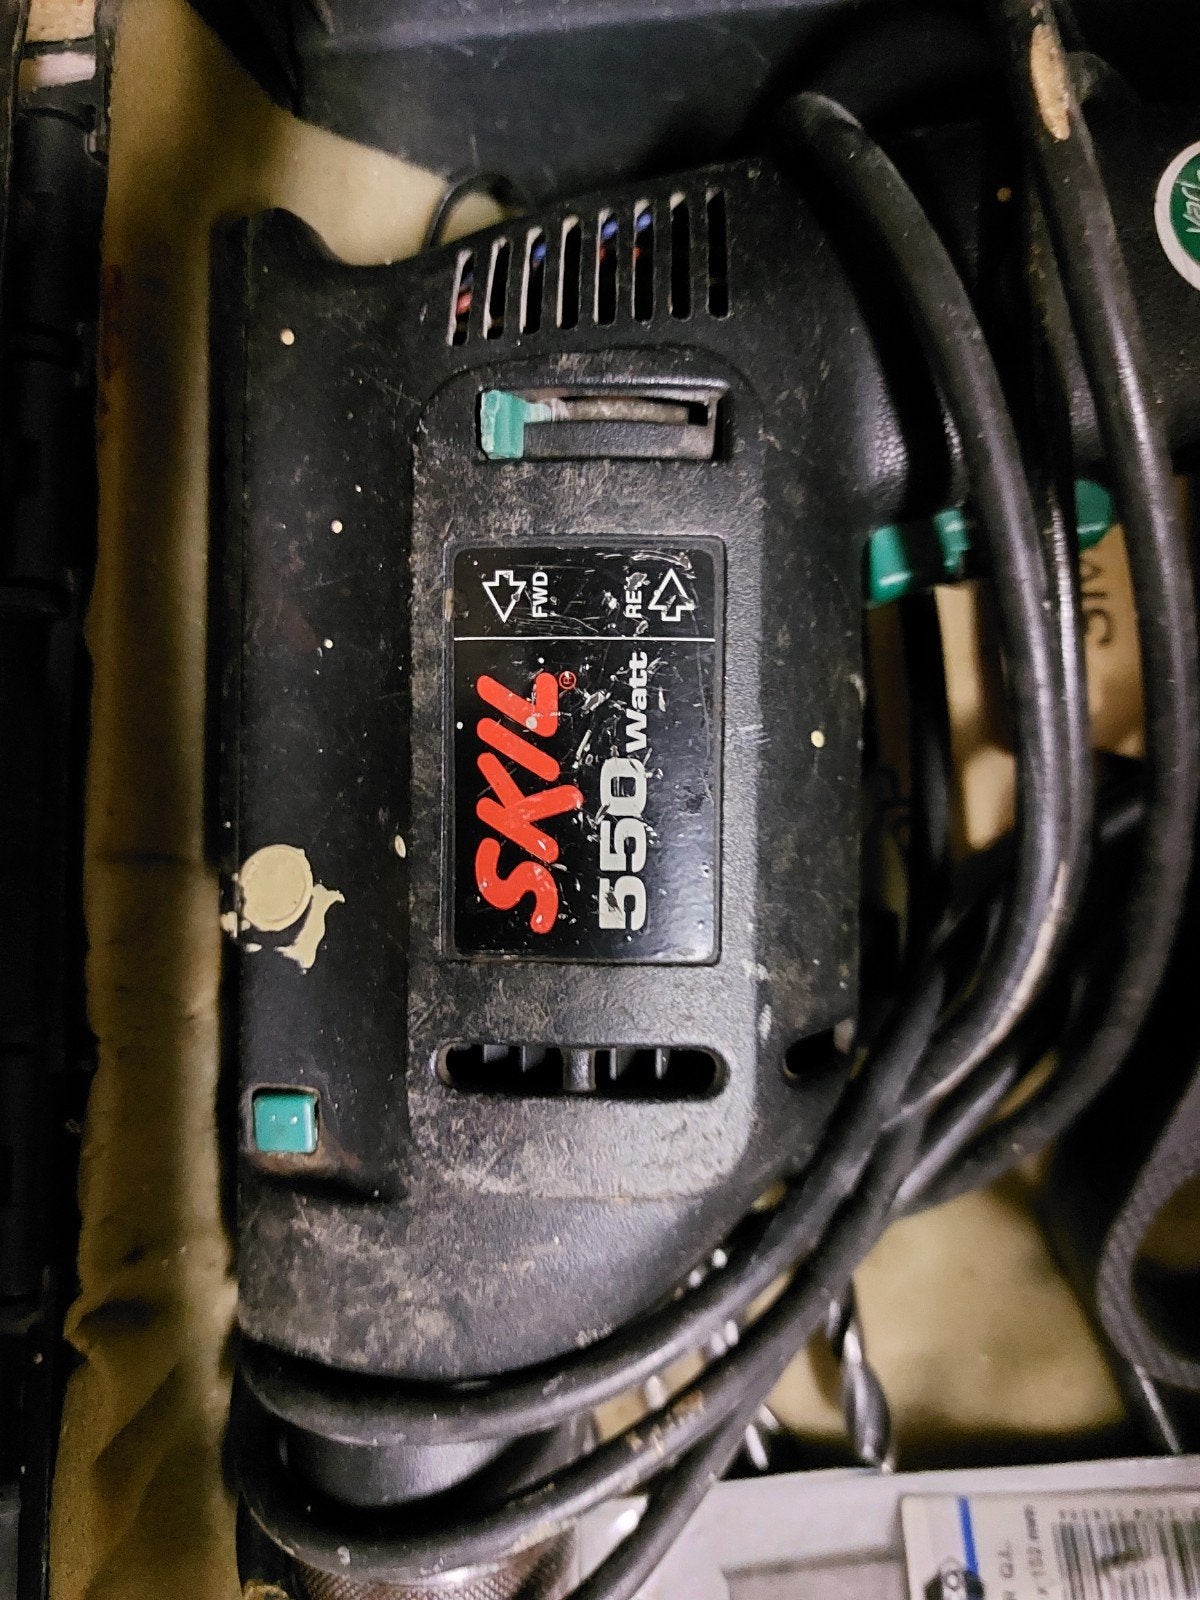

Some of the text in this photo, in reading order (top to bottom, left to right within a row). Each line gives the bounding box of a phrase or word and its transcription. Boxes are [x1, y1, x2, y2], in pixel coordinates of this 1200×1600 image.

[532, 571, 548, 618] FWD
[625, 573, 643, 618] RE
[475, 672, 583, 934] SKIL
[599, 758, 647, 931] 550
